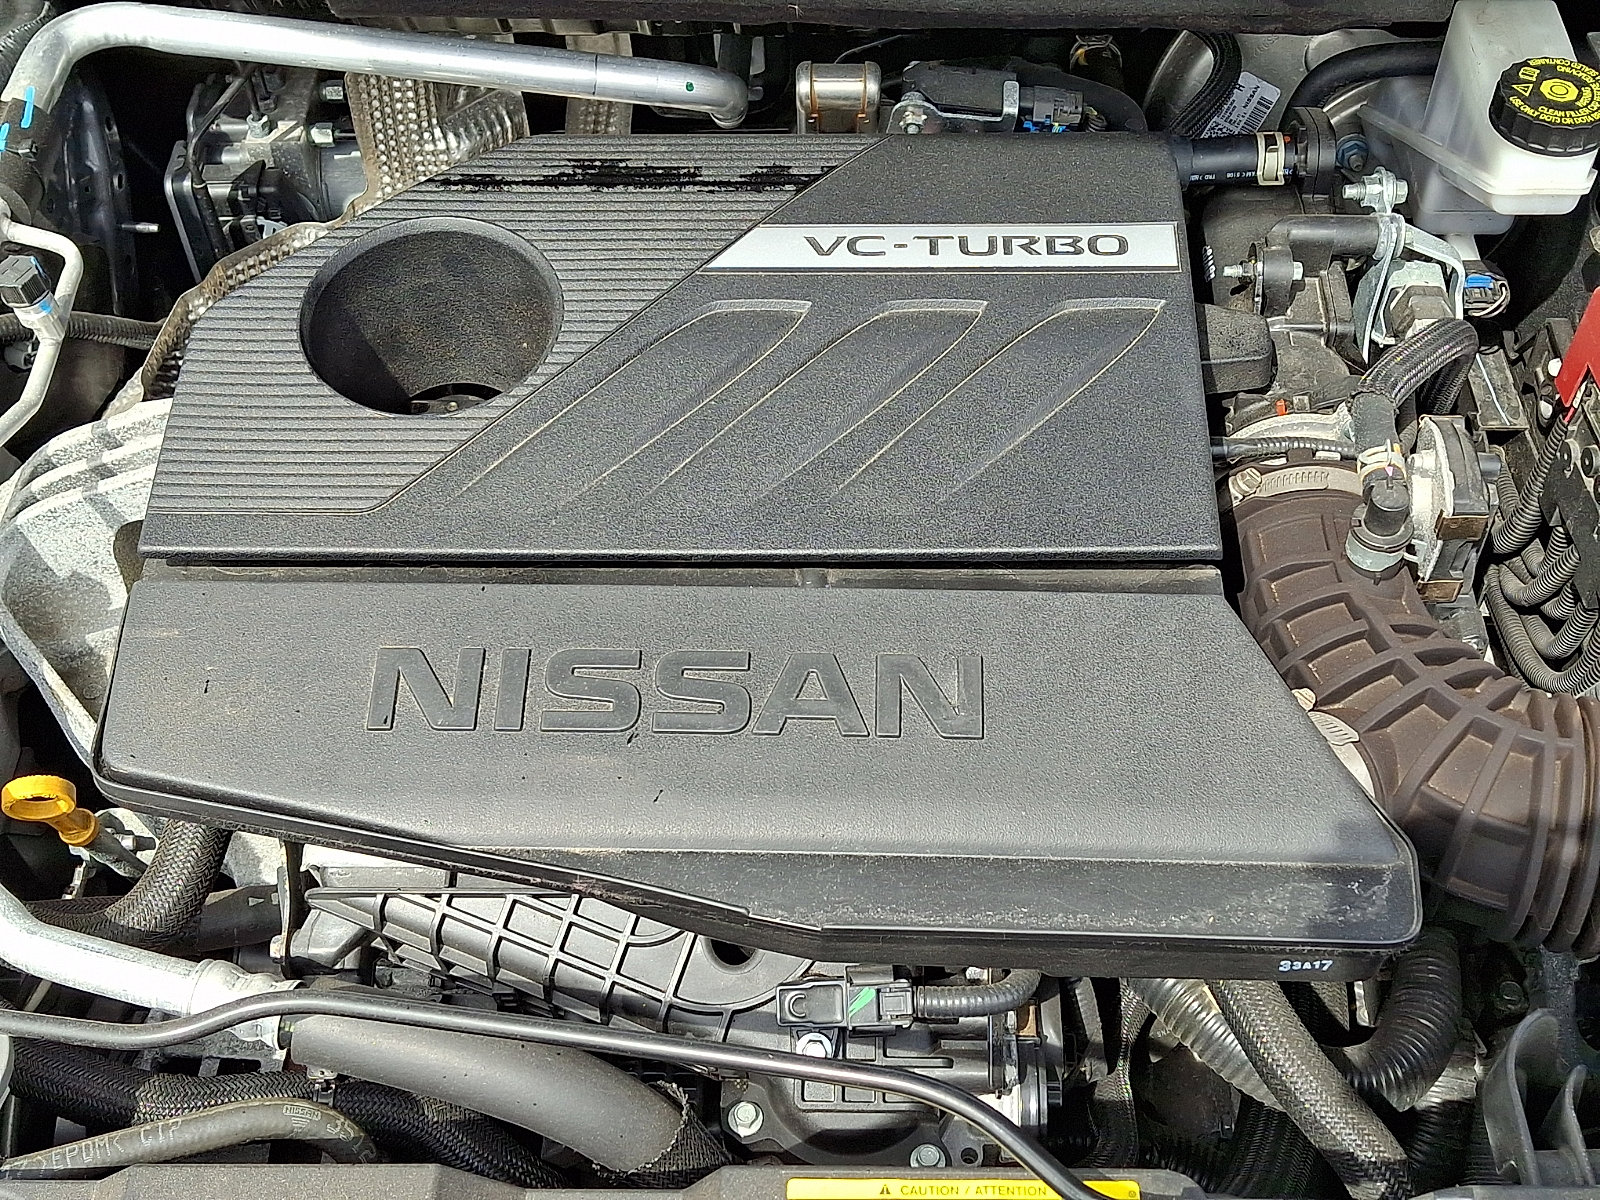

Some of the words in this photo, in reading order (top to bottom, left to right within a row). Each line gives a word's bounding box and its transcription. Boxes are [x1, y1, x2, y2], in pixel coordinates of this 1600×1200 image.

[1527, 58, 1571, 66] CONTAINER
[1571, 62, 1599, 77] SEALED
[1556, 65, 1596, 84] REMOVING
[1241, 84, 1260, 110] NISSAN
[1521, 105, 1541, 118] ONLY
[1539, 113, 1561, 124] DOT3
[1562, 117, 1575, 125] OR
[1538, 105, 1565, 118] CLEAN
[1566, 107, 1592, 118] FILLER
[803, 234, 1129, 256] VC-TURBO
[366, 646, 985, 740] NISSAN
[1278, 959, 1333, 972] 33A17
[284, 1105, 320, 1120] NISSAN
[900, 1185, 959, 1196] CAUTION
[975, 1185, 1047, 1196] ATTENTION
